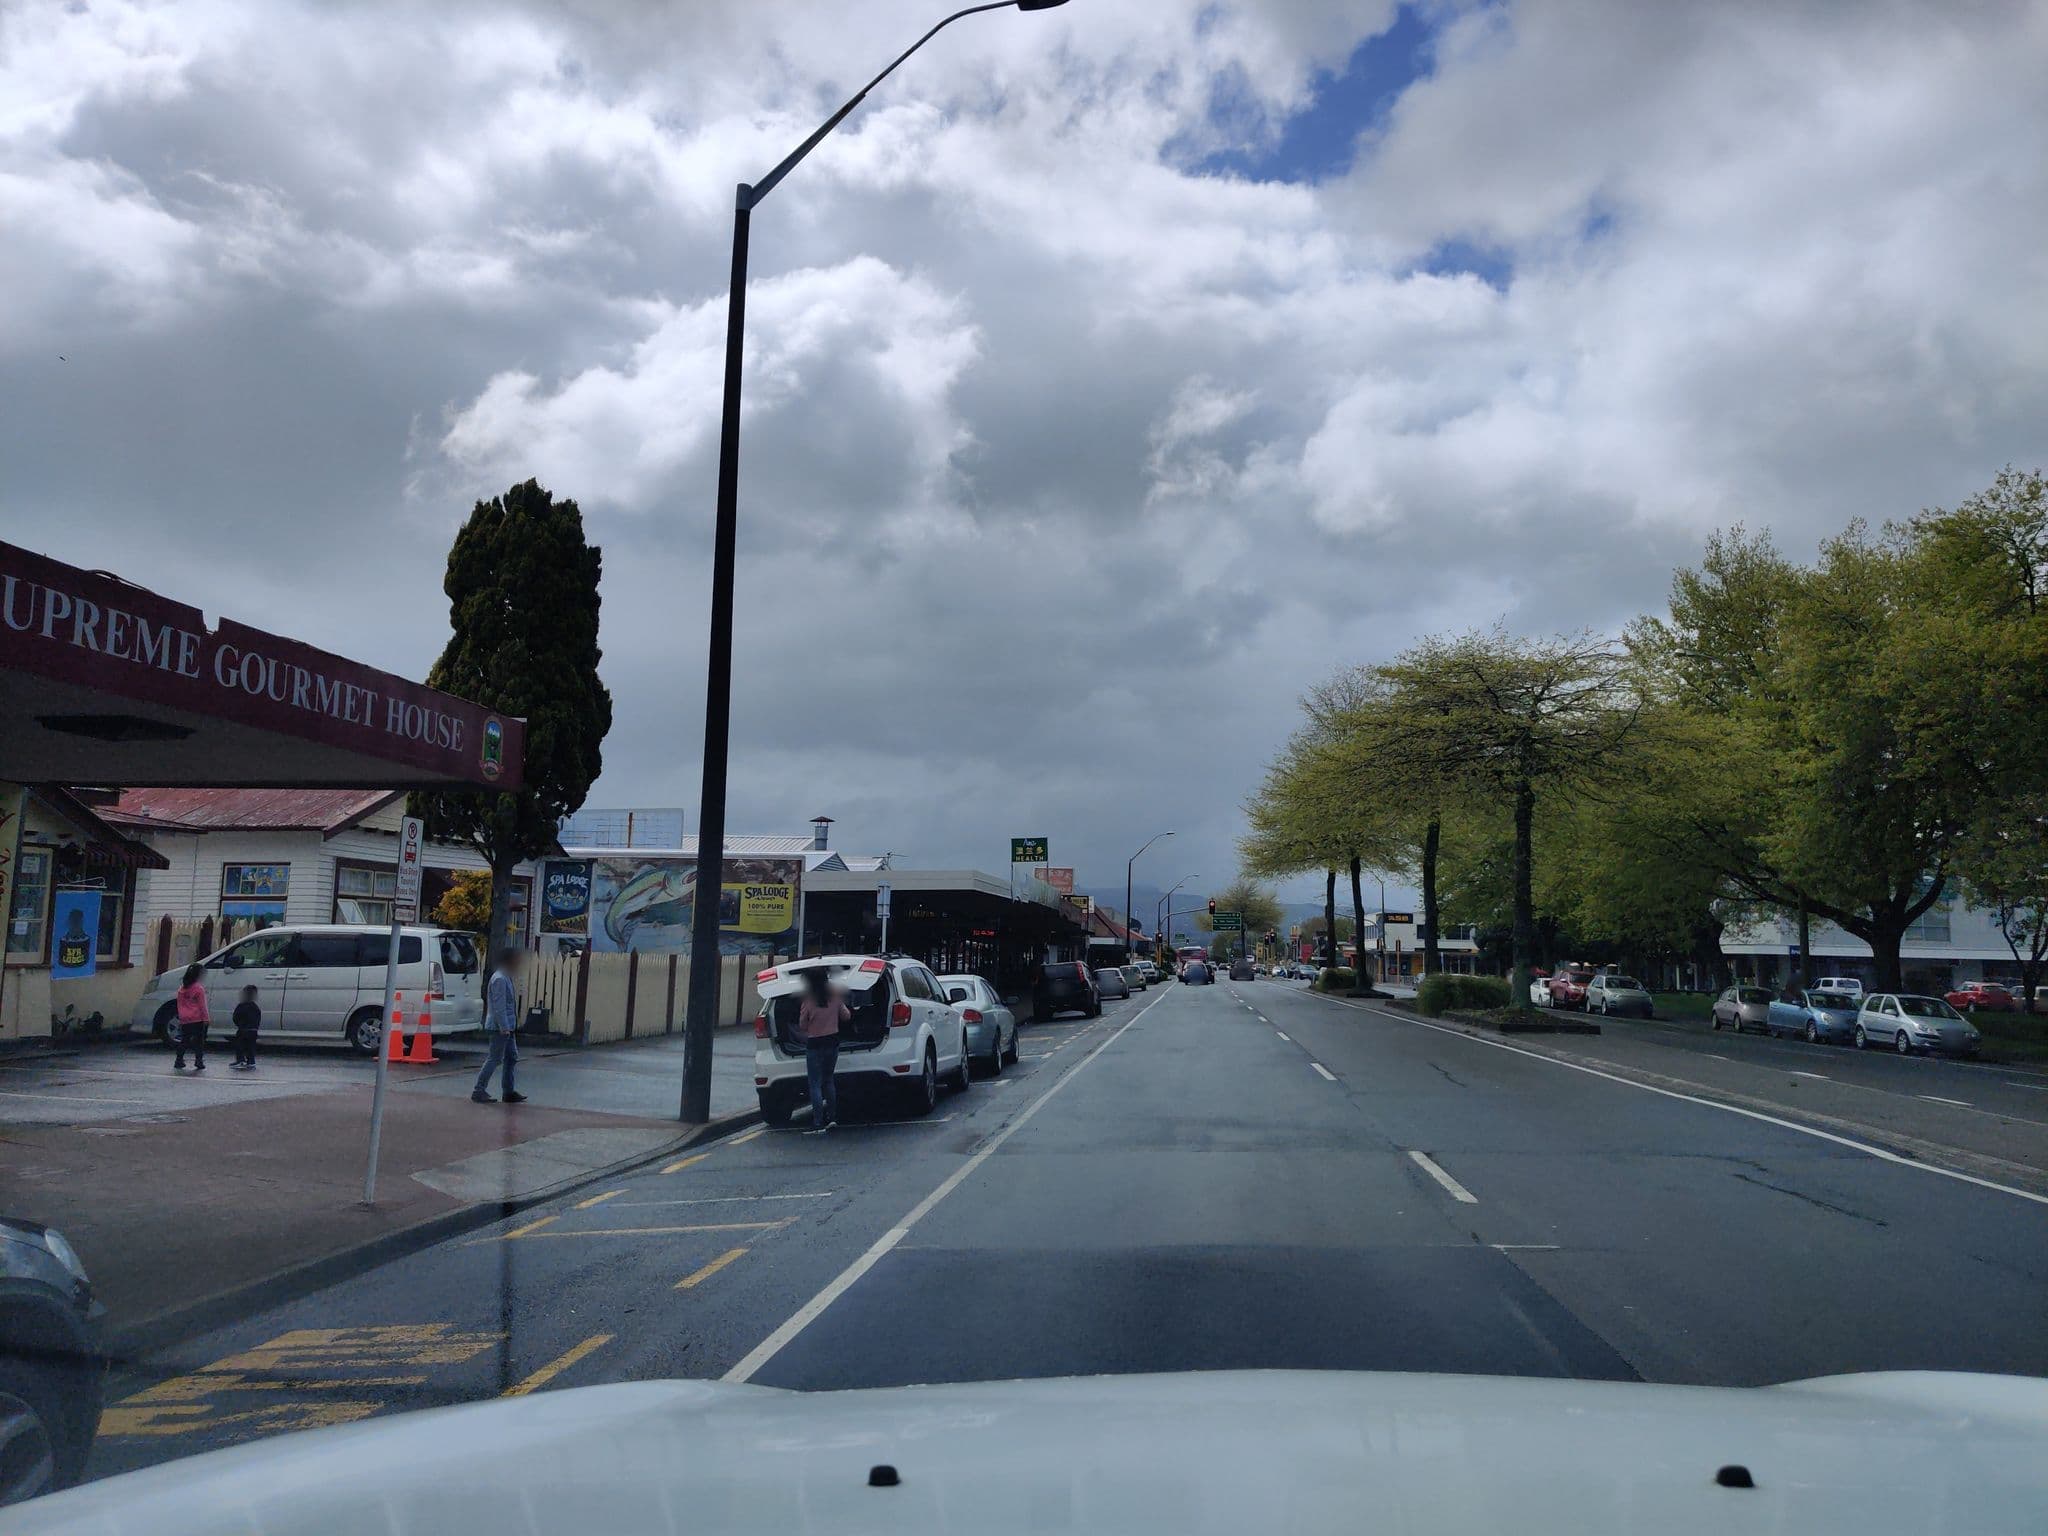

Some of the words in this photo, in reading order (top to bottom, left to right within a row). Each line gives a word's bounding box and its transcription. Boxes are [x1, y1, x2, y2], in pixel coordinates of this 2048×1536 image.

[214, 644, 378, 728] GOURMET
[385, 696, 464, 751] HOUSE
[547, 873, 565, 888] SPA
[745, 886, 762, 899] SPA
[763, 886, 789, 900] LODGE
